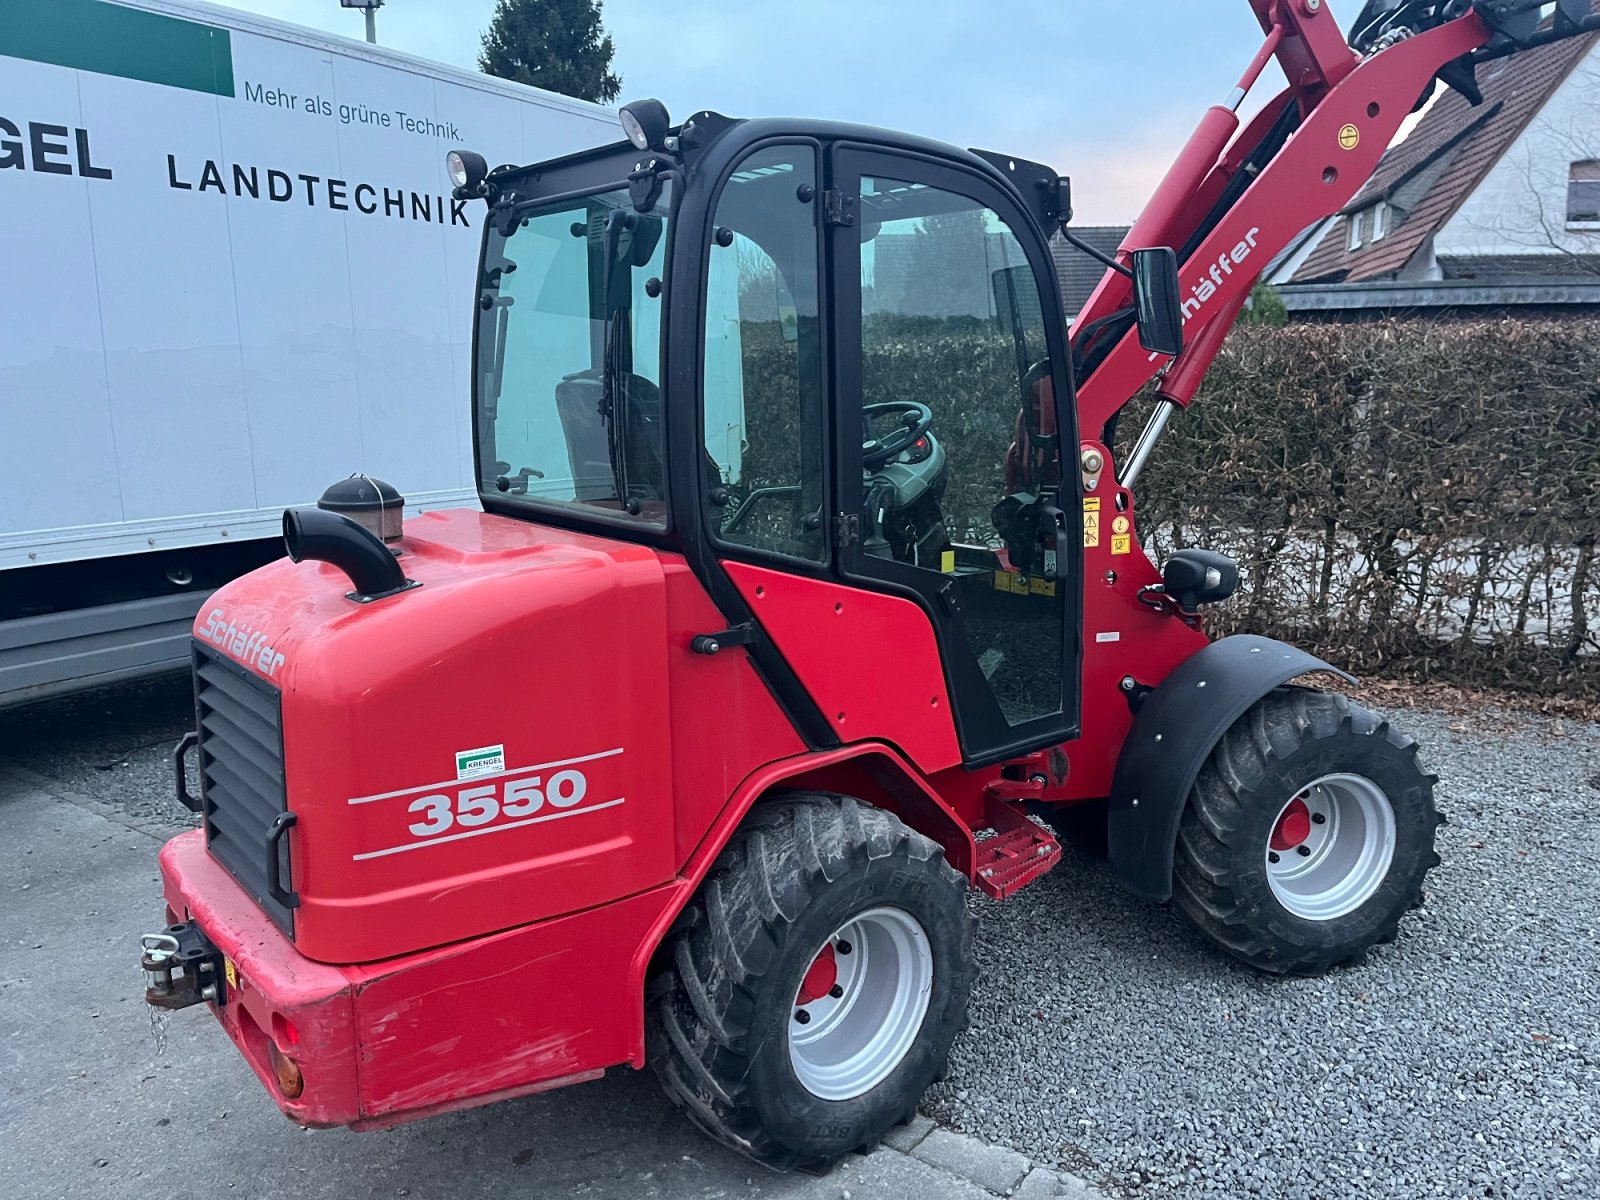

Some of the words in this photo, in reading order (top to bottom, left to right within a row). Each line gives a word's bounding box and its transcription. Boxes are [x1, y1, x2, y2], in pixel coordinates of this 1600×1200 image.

[245, 81, 297, 110] Mehr
[305, 96, 332, 116] als
[339, 104, 391, 128] grüne
[396, 111, 464, 142] Technik.
[167, 154, 470, 228] LANDTECHNIK
[198, 608, 285, 677] Schäffer
[468, 757, 503, 769] KRENGEL
[408, 769, 587, 837] 3550
